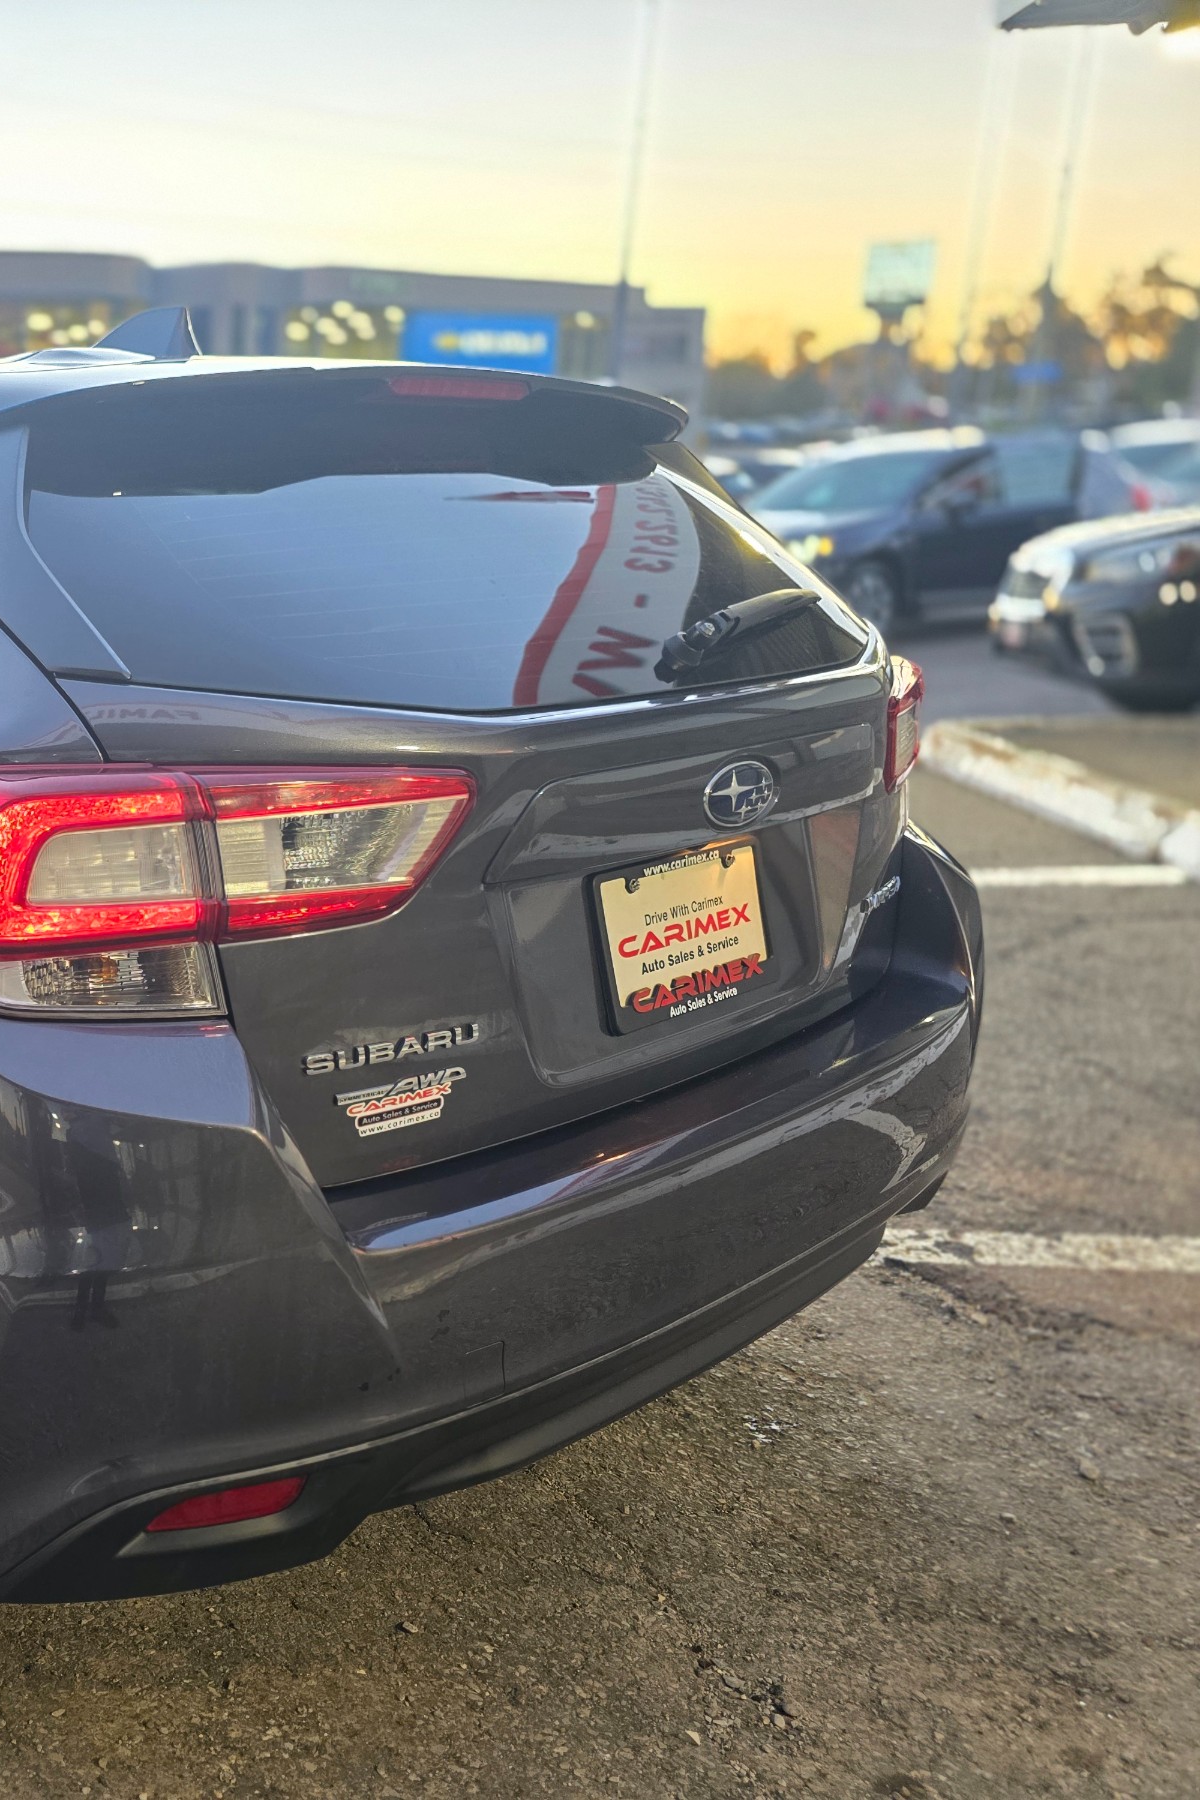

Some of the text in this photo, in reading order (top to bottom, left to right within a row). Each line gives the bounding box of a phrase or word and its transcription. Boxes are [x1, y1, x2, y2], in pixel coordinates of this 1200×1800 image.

[643, 850, 719, 876] www.carimex.ca
[644, 895, 724, 927] Drive With Carimex
[618, 903, 751, 958] CARIMEX
[641, 935, 739, 976] Auto Sales & Service
[631, 953, 764, 1013] CARIMEX
[670, 986, 738, 1018] Auto Sales & Service
[303, 1023, 479, 1076] SUBARU
[387, 1066, 467, 1096] AWD
[348, 1083, 451, 1115] CARIMEX
[362, 1101, 439, 1126] Auto Sales & Service
[359, 1111, 440, 1136] www.carimex.ca
